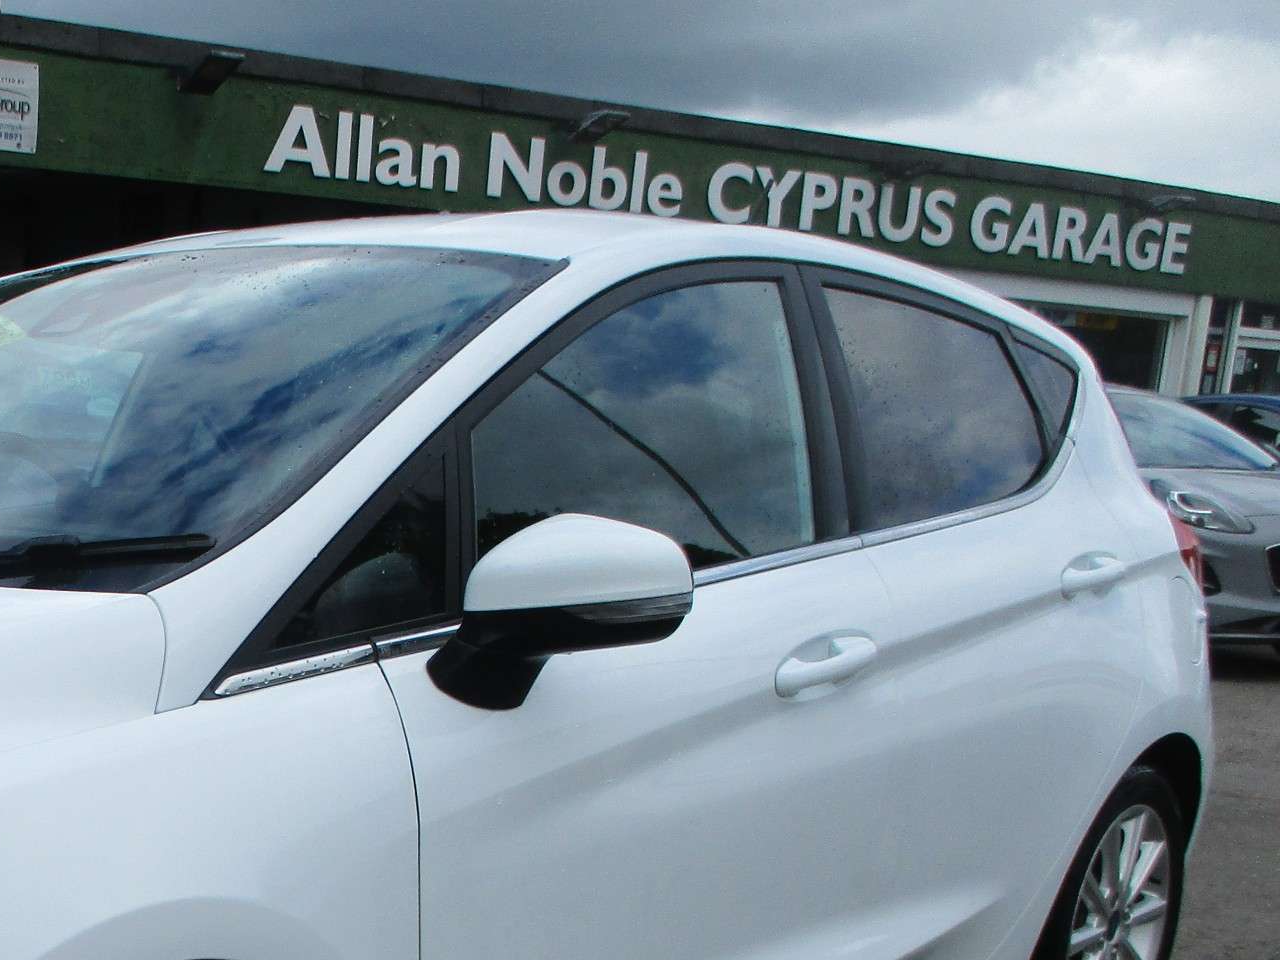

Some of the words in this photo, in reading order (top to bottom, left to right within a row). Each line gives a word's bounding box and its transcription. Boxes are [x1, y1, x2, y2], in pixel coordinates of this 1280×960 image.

[263, 103, 461, 194] Allan
[486, 131, 683, 217] Noble
[706, 161, 957, 248] CYPRUS
[969, 195, 1192, 275] GARAGE
